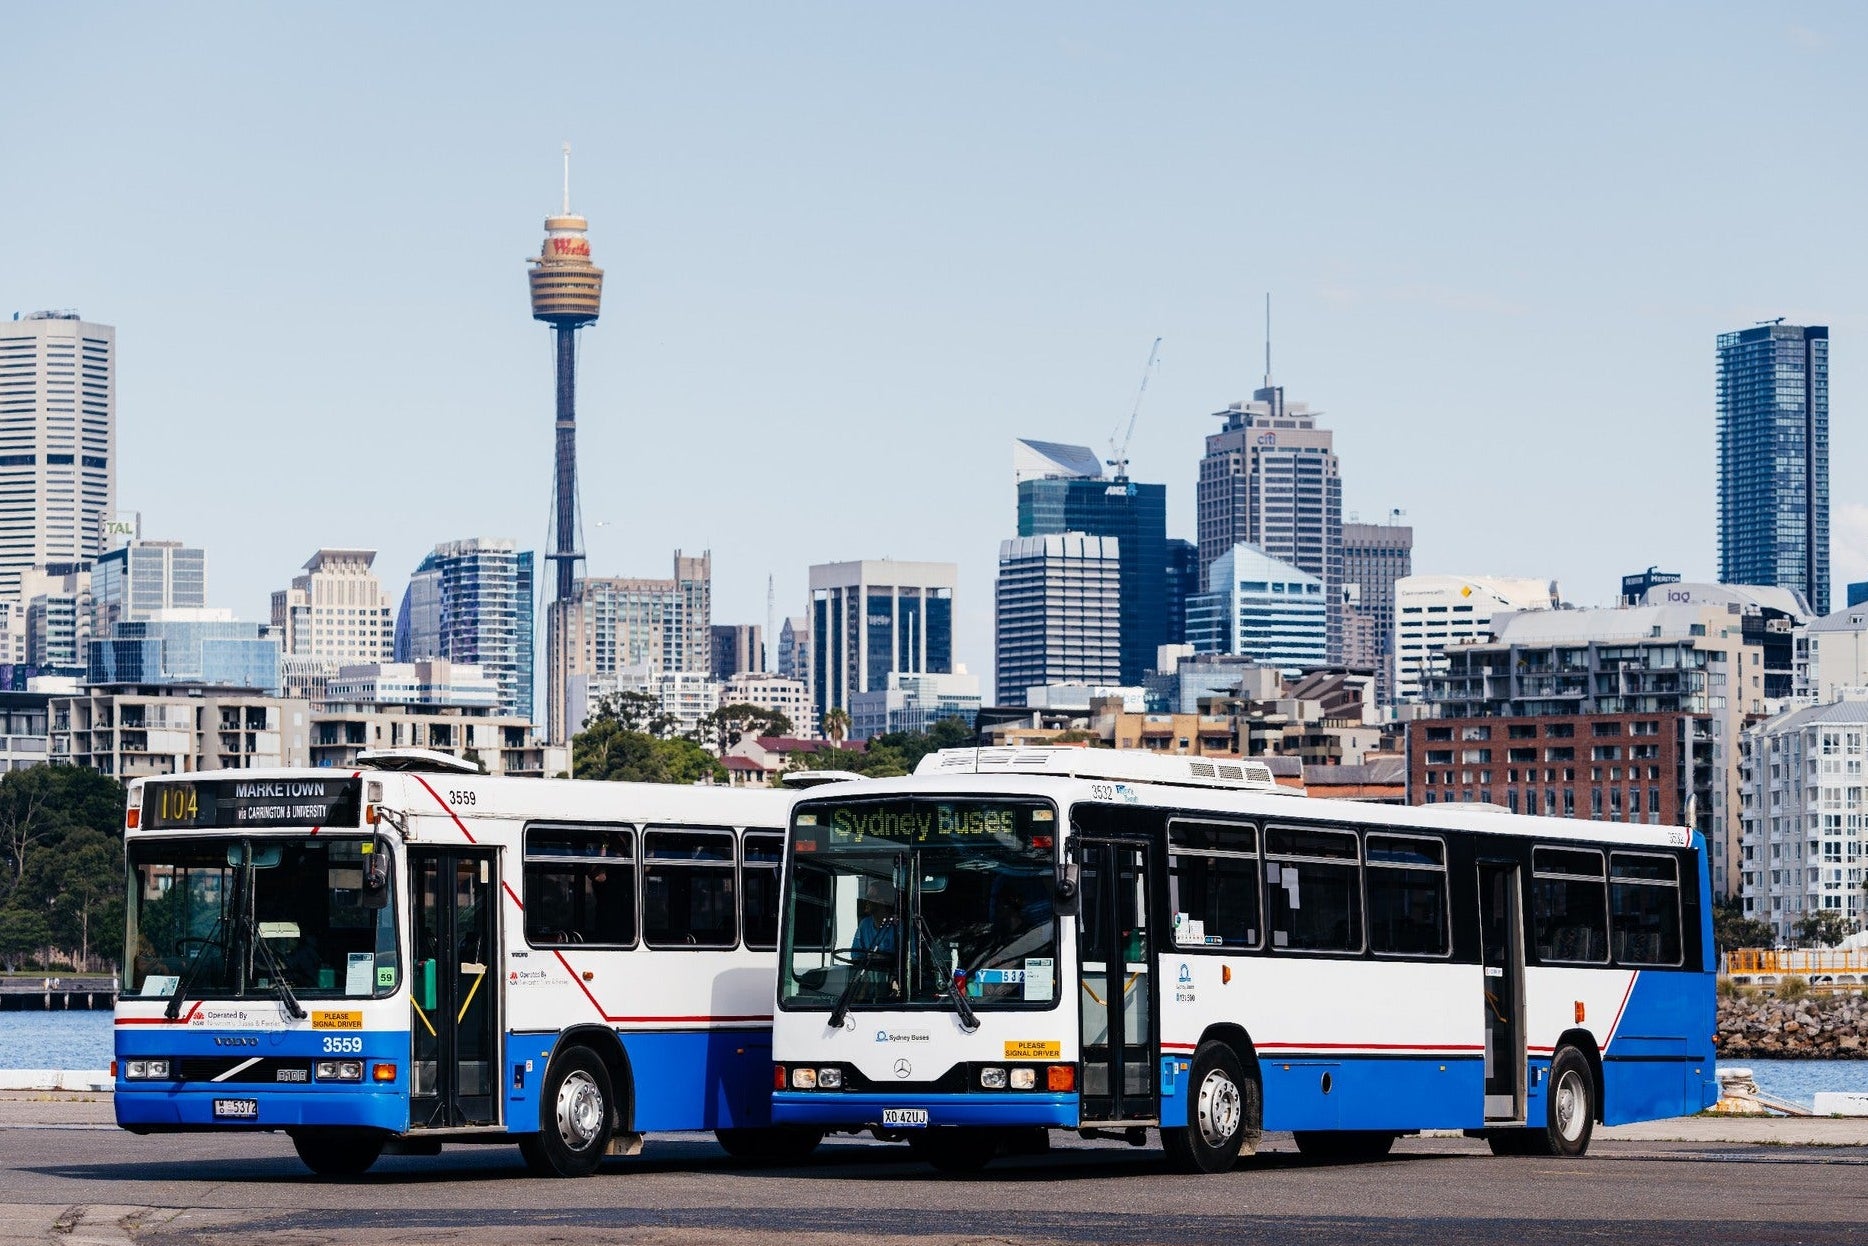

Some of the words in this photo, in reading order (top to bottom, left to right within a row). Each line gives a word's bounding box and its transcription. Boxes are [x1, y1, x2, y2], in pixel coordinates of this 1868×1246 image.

[1257, 431, 1276, 446] citi
[107, 522, 133, 534] TAL
[1667, 589, 1690, 603] iag
[236, 782, 325, 798] MARKETOWN
[1091, 784, 1113, 801] 3532
[162, 789, 198, 819] 104
[449, 790, 476, 806] 3559
[248, 805, 285, 819] CARRINGTON
[292, 804, 327, 818] UNIVERSITY
[834, 808, 932, 843] Sydney
[937, 806, 1014, 835] Buses
[380, 973, 393, 982] 59
[1003, 970, 1025, 983] 532
[207, 1010, 237, 1019] Operated
[239, 1011, 248, 1020] By
[312, 1020, 336, 1028] SIGNAL
[337, 1020, 362, 1028] DRIVER
[213, 1037, 259, 1047] VOLVO
[322, 1036, 363, 1053] 3559
[889, 1034, 910, 1042] Sydney
[233, 1101, 257, 1114] 5372
